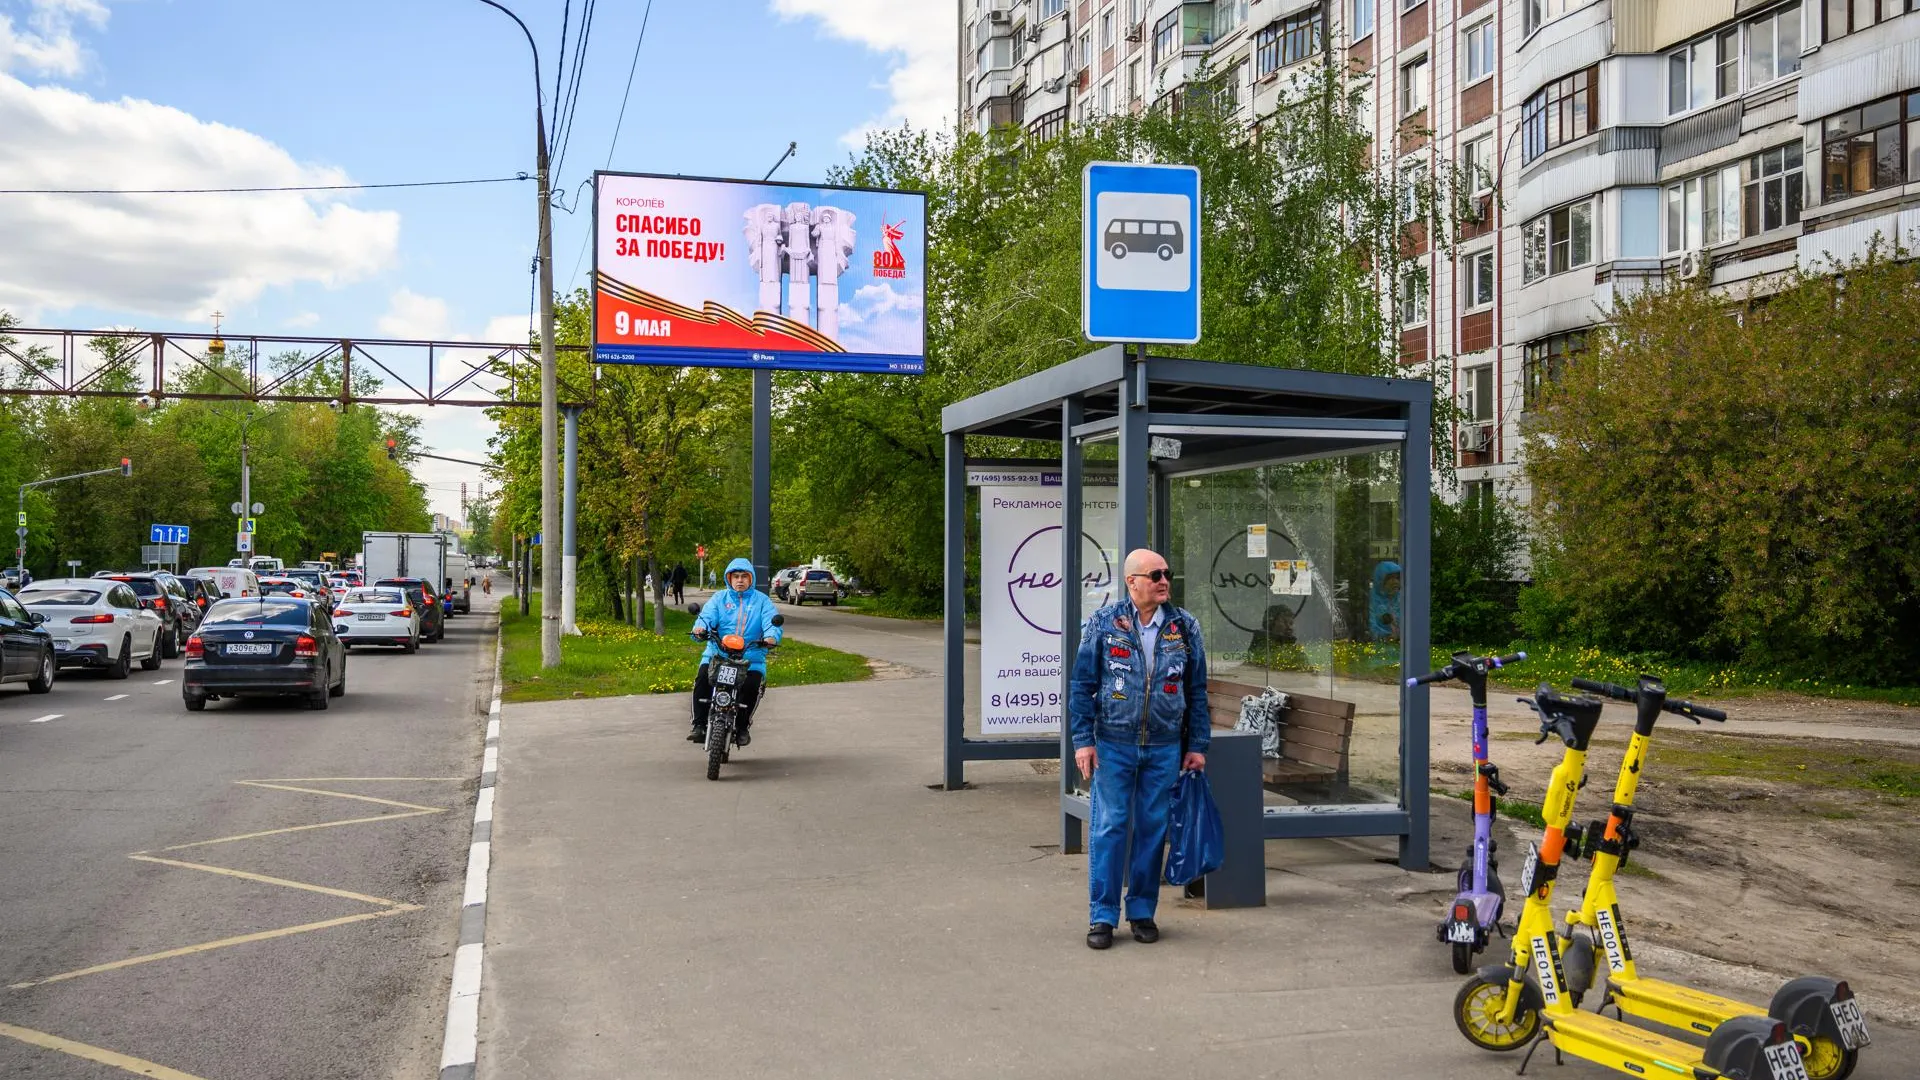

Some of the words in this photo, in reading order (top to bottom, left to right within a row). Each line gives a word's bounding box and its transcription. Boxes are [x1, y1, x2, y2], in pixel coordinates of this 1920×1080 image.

[616, 197, 665, 208] КОРОЛЁВ
[616, 213, 701, 236] СПАСИБО
[616, 237, 640, 257] ЗА
[647, 239, 725, 263] ПОБЕДУ!
[873, 251, 891, 267] 80
[873, 269, 906, 279] ПОБЕДА!
[615, 310, 630, 336] 9
[634, 318, 671, 337] МАЯ
[981, 475, 1001, 483] (495)
[1002, 475, 1039, 483] 955-92-93
[993, 498, 1062, 509] Рекламное
[1009, 572, 1102, 588] нен
[1021, 652, 1061, 665] Яркое
[997, 669, 1021, 678] для
[991, 694, 1001, 707] 8
[1005, 691, 1045, 708] (495)
